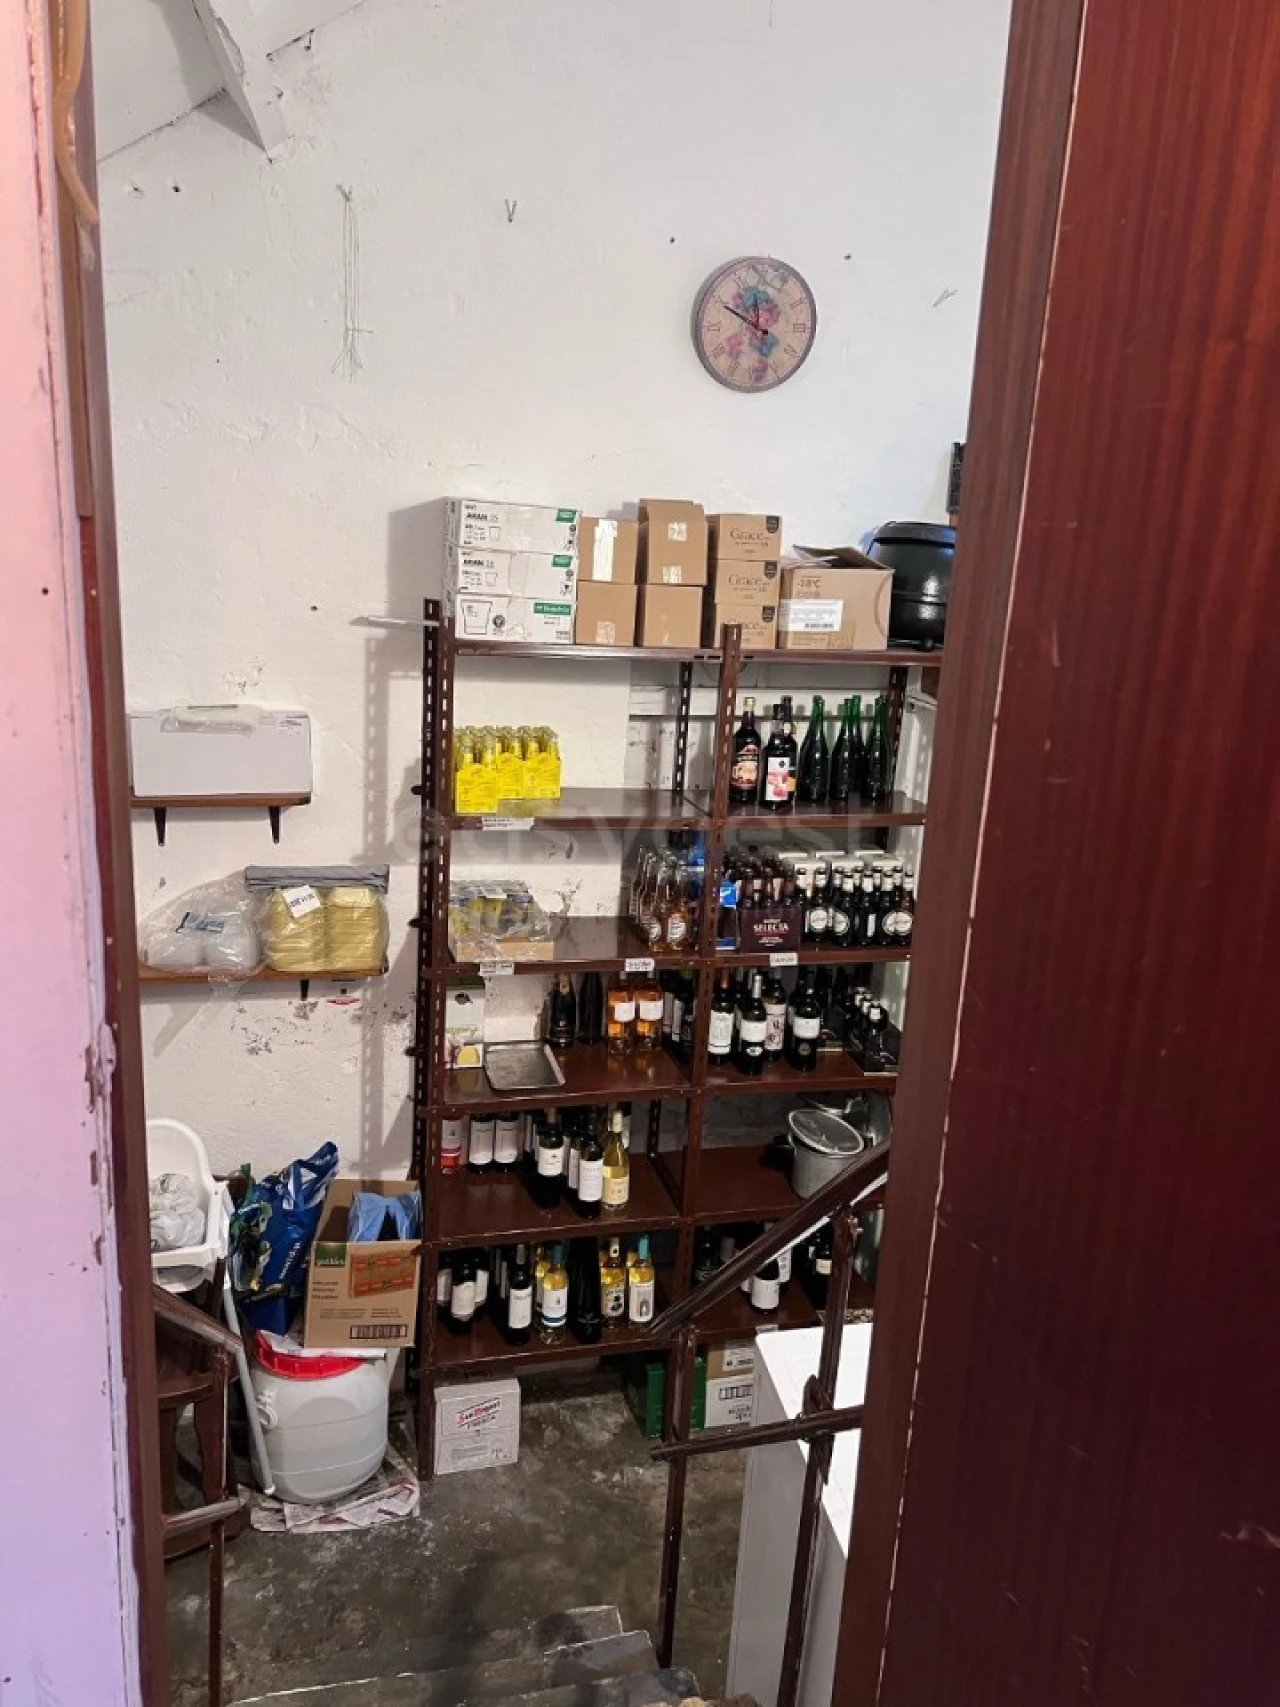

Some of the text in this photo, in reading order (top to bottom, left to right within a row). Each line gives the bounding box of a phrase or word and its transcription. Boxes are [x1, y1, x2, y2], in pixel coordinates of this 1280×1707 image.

[730, 527, 764, 541] Grace
[728, 573, 762, 587] Grace
[753, 922, 789, 933] SELECTA
